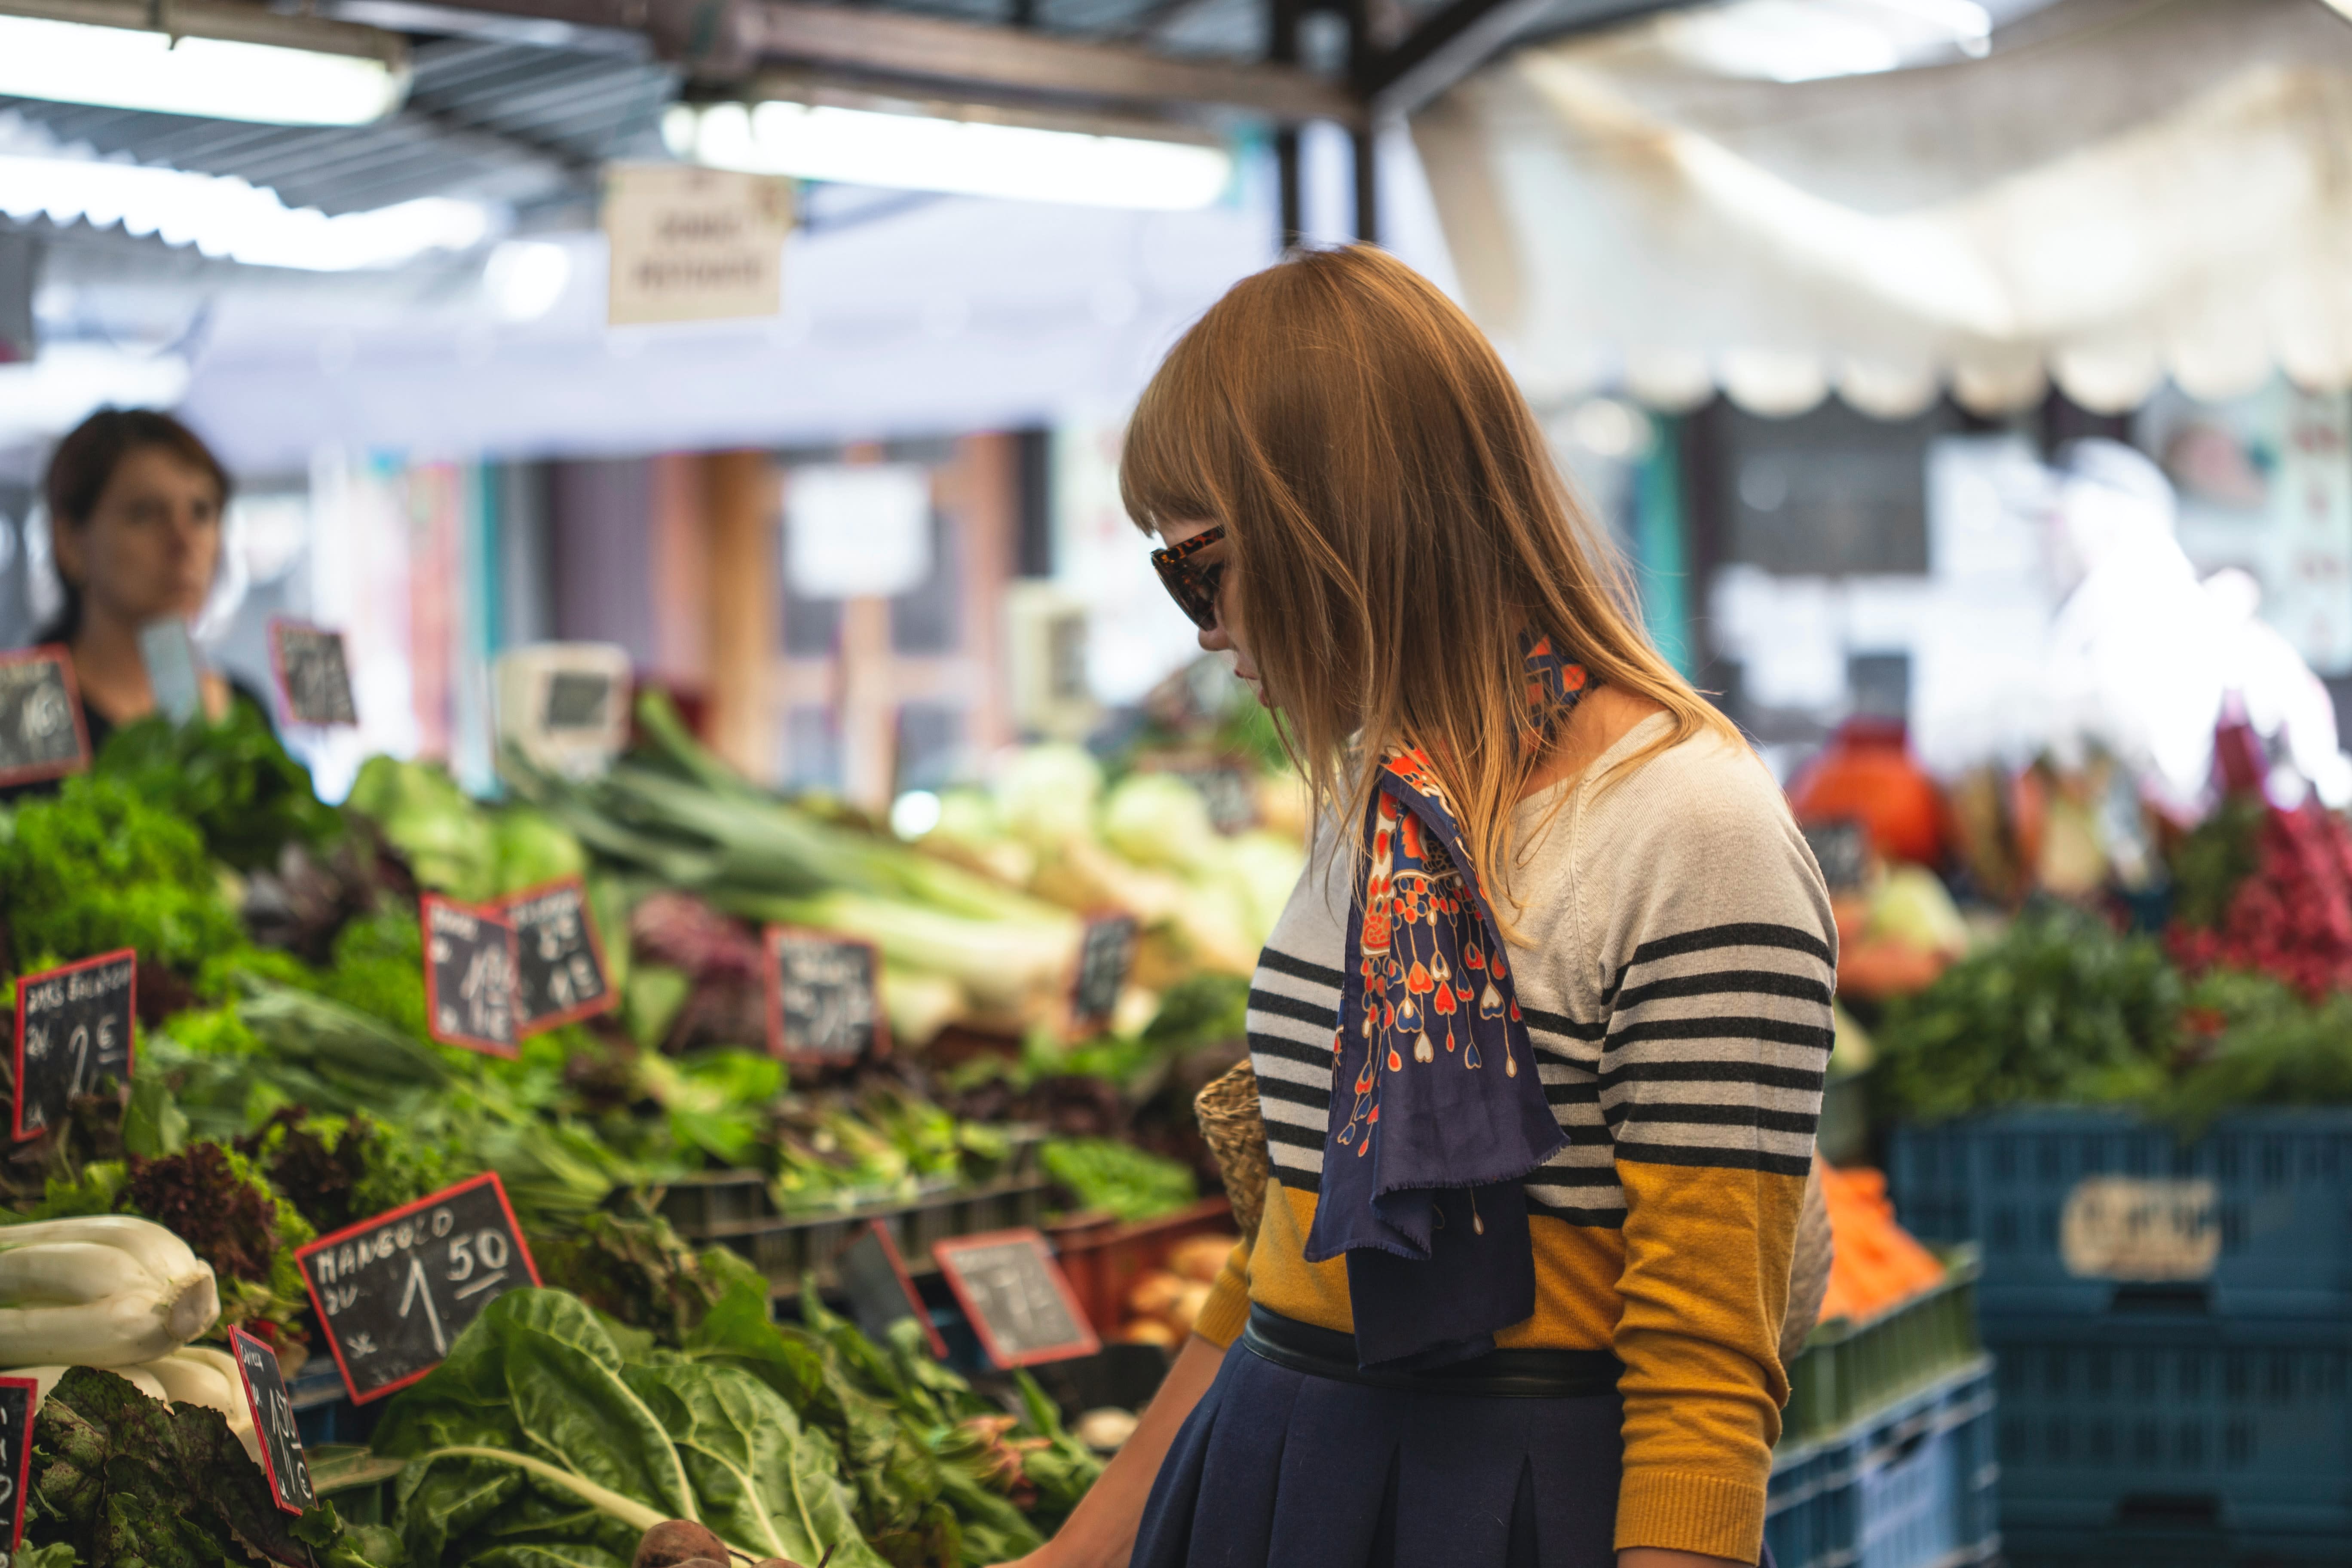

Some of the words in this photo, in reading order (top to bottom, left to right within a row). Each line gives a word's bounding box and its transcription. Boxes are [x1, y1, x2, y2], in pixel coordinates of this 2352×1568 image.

[316, 1207, 453, 1283] MANGOLD
[398, 1256, 447, 1357] 1
[446, 1228, 509, 1281] 50
[297, 1461, 312, 1500] €
